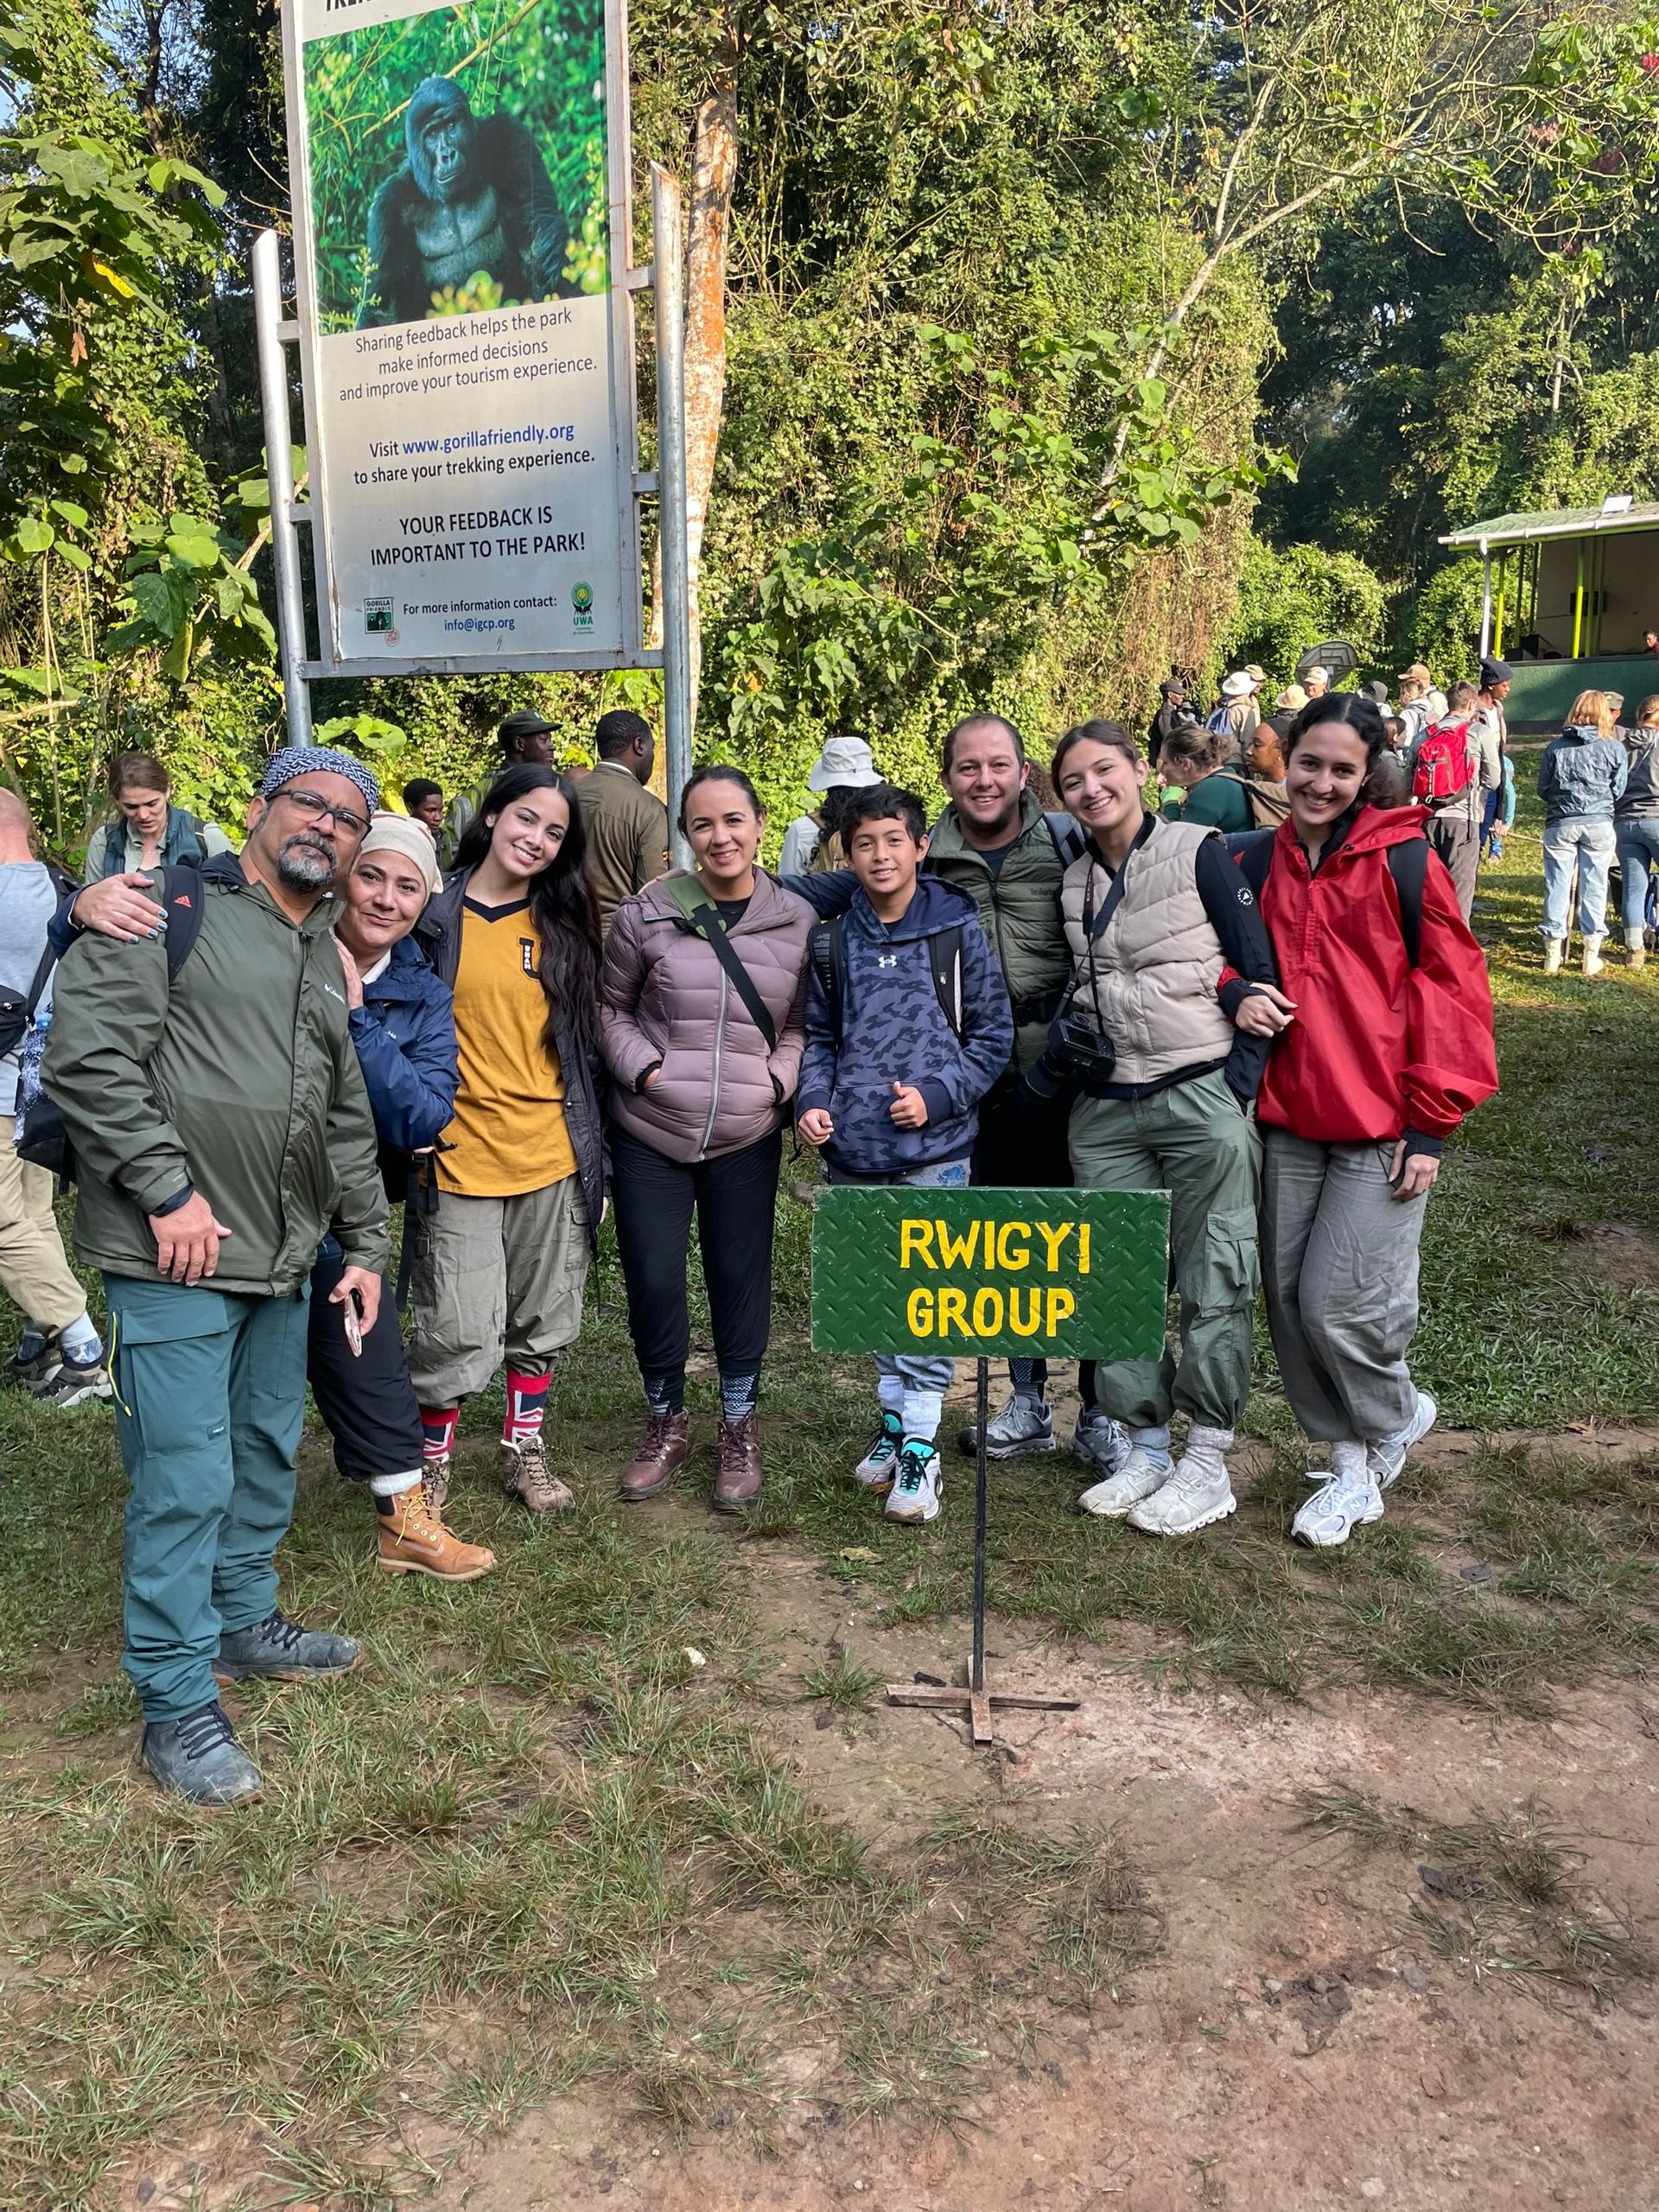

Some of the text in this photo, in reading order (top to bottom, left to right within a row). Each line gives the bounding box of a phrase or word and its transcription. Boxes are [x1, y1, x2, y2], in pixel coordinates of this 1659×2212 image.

[356, 307, 572, 353] Sharing feedback helps the park
[379, 340, 548, 375] make informed decisions
[340, 358, 596, 401] and improve your tourism experience.
[370, 424, 575, 458] Visit www.gorillafriendly.org
[354, 448, 595, 484] to share your trekking experience.
[399, 505, 552, 537] YOUR FEEDBACK IS
[371, 532, 584, 566] IMPORTANT TO THE PARK!
[404, 596, 556, 614] For more information contact:
[573, 616, 594, 626] UWA
[444, 618, 515, 632] info@igcp.org
[899, 1219, 1090, 1274] RWIGYI
[906, 1287, 1076, 1338] GROUP
